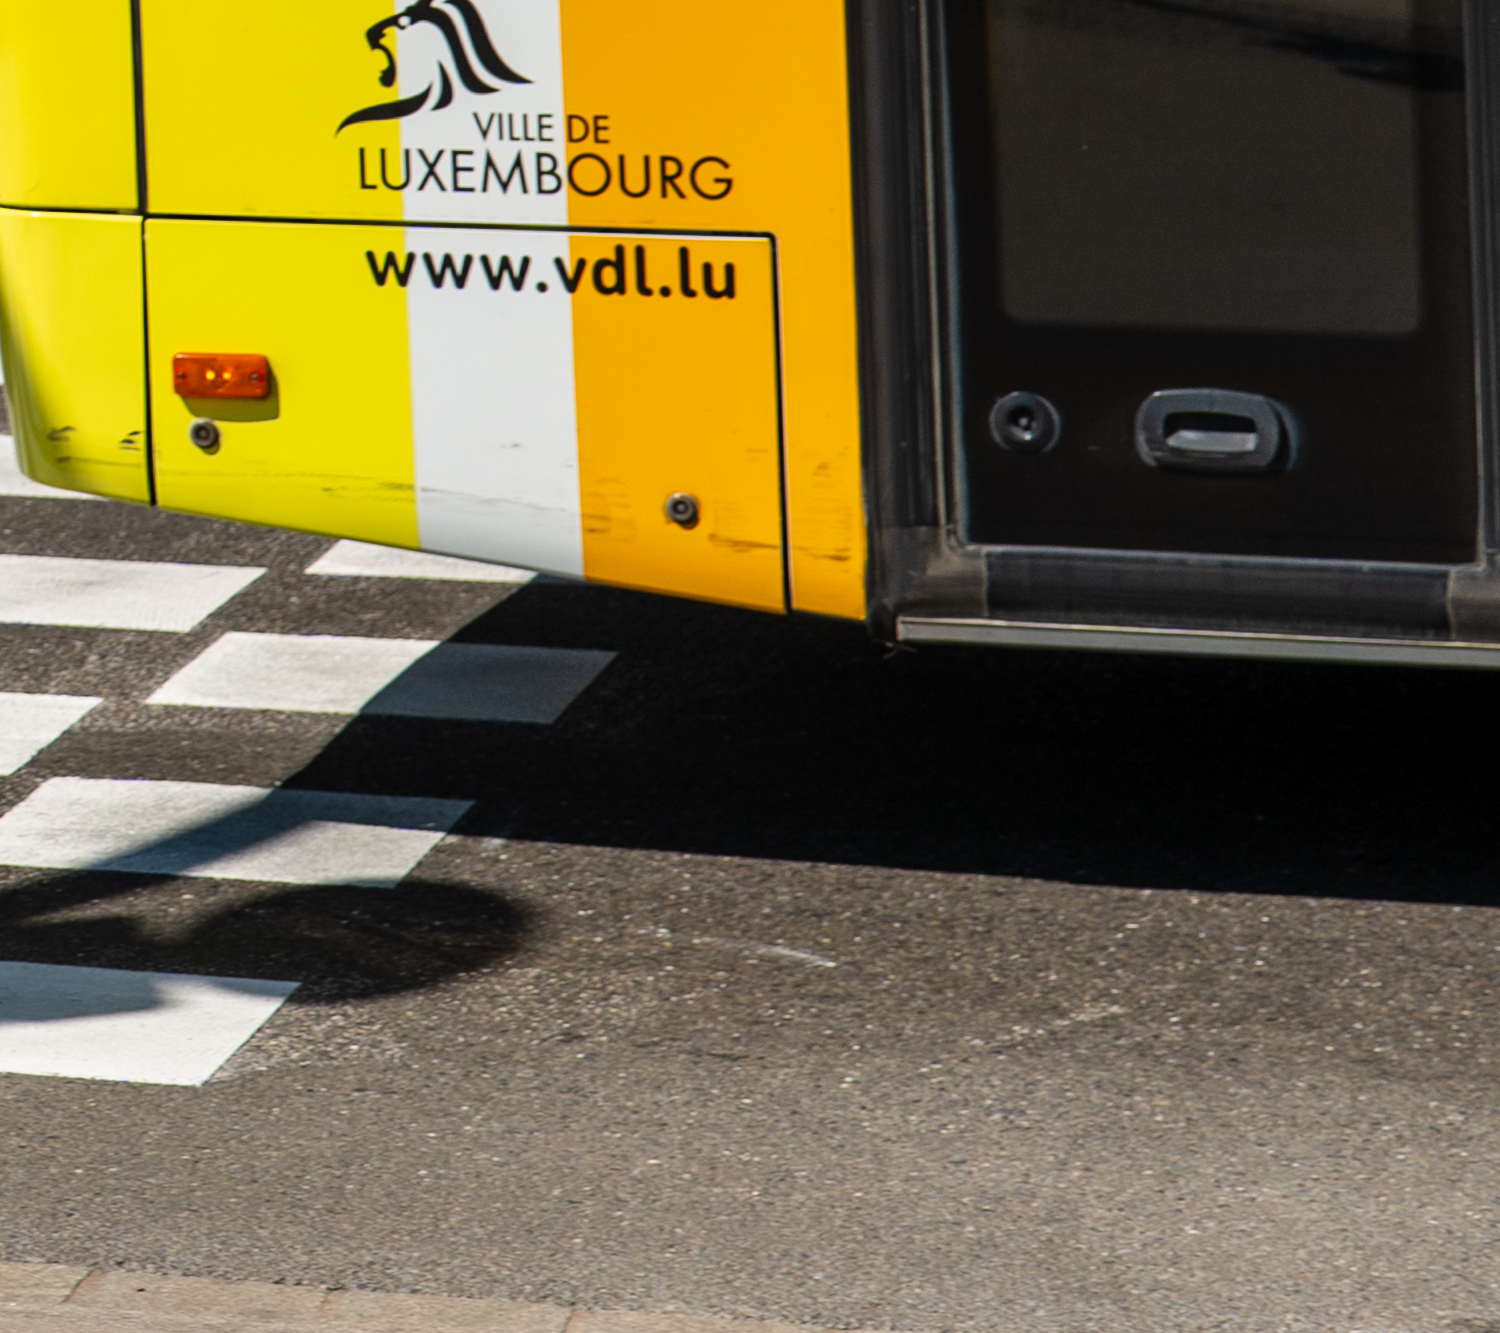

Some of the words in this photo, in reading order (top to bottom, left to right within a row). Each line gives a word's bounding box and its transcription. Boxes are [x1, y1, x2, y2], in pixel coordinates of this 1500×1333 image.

[472, 112, 555, 143] VILLE
[566, 115, 611, 144] DE
[359, 148, 734, 200] LUXEMBOURG
[366, 244, 737, 300] www.vdl.lu
